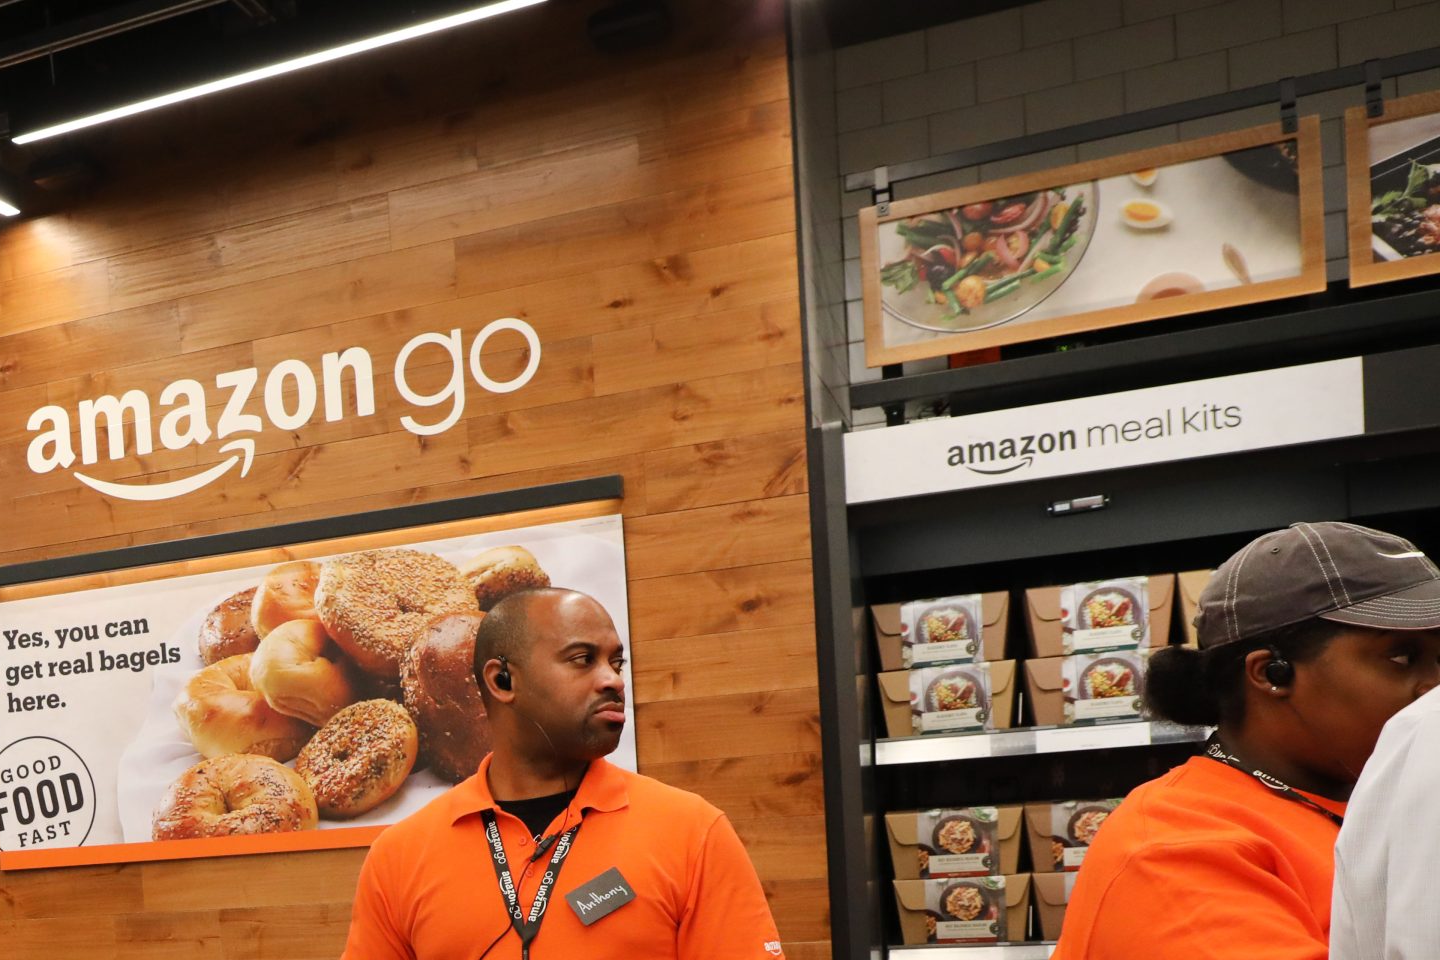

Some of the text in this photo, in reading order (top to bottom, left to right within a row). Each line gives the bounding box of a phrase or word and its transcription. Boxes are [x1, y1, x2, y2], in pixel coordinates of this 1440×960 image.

[26, 317, 541, 474] amazon go
[947, 402, 1242, 466] amazon meal kits
[3, 617, 150, 650] Yes, you can
[5, 642, 181, 686] get real bagels
[7, 692, 67, 713] here.
[0, 755, 62, 784] GOOD
[18, 820, 71, 847] FAST
[488, 821, 506, 864] amazon go
[502, 871, 516, 905] amazon
[528, 871, 553, 922] amazon go
[576, 885, 627, 914] Anthony
